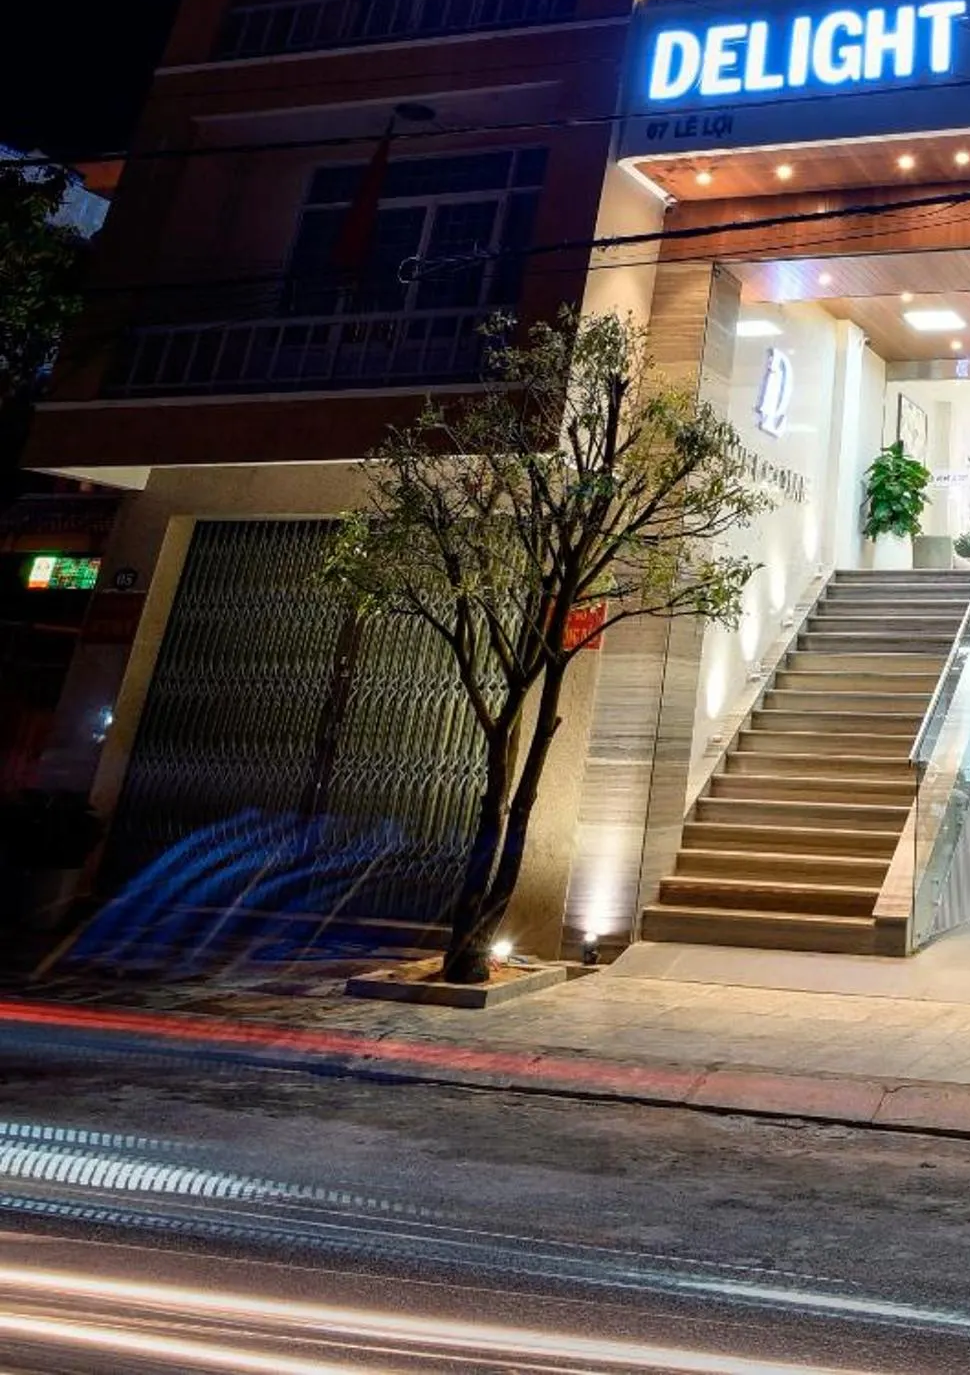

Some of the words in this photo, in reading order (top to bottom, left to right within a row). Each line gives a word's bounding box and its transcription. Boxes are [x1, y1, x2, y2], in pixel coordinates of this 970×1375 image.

[649, 0, 967, 99] DELIGHT
[646, 120, 670, 140] 07
[674, 116, 697, 139] LÊ
